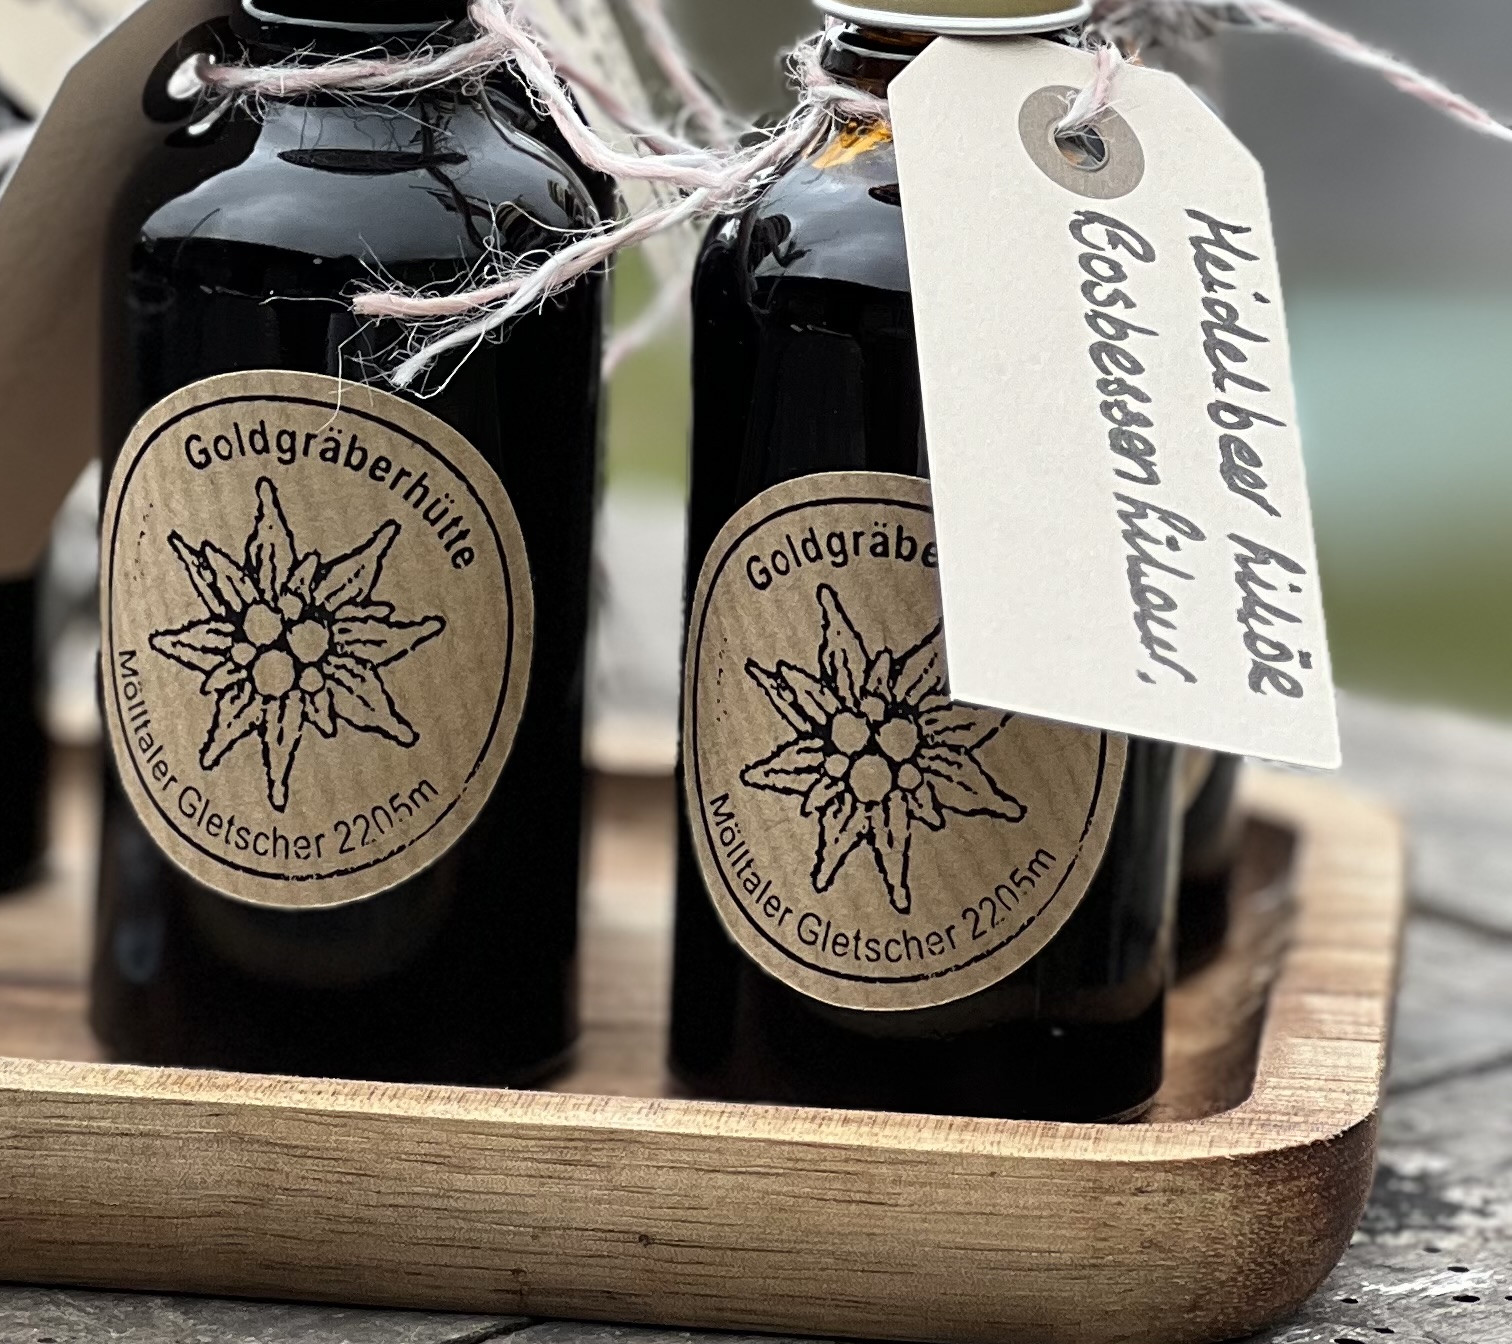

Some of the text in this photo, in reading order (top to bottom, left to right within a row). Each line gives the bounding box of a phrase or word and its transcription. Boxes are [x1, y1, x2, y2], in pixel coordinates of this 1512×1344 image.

[185, 420, 476, 571] Goldgräberhütte
[118, 649, 440, 860] Mölltaler Gletscher 2205m
[709, 793, 1058, 964] Mölltaler Gletscher 2205m
